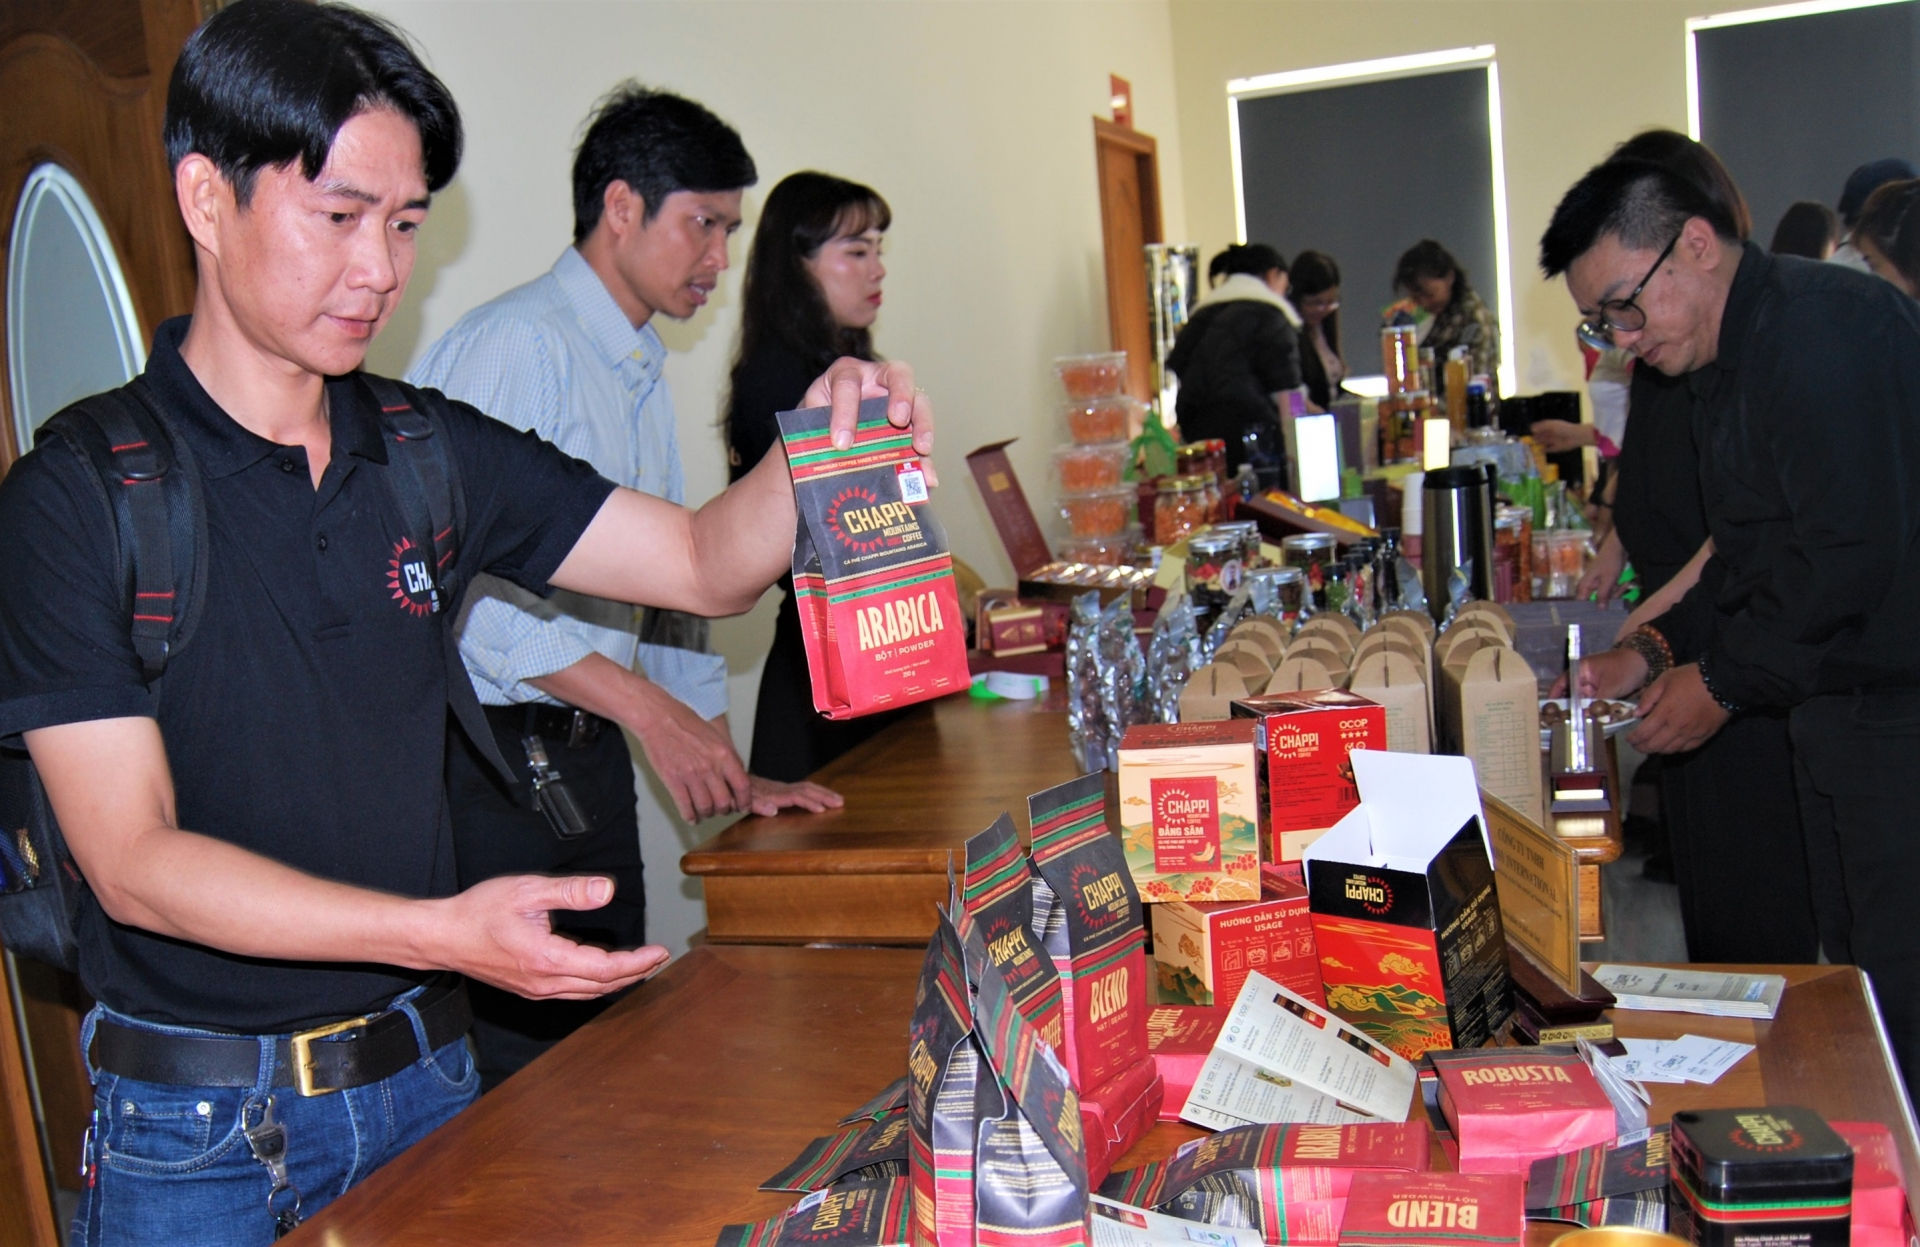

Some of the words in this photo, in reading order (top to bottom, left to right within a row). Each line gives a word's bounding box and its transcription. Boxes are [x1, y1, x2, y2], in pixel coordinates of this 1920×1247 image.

[843, 501, 916, 534] CHAPPI
[883, 522, 920, 537] MOUNTAINS
[902, 531, 923, 543] COFFEE
[856, 591, 944, 651] ARABICA
[875, 650, 893, 662] BỘT
[899, 639, 935, 655] POWDER
[1339, 718, 1368, 729] OCOP
[1280, 733, 1319, 749] CHAPPI
[1167, 799, 1209, 814] CHAPPI
[1082, 872, 1127, 911] CHAPPI
[1345, 884, 1384, 903] CHAPPI
[1255, 921, 1283, 932] USAGE
[987, 924, 1029, 968] CHAPPI
[1089, 967, 1129, 1024] BLEND
[909, 1039, 939, 1095] CHAPPI
[1461, 1065, 1572, 1086] ROBUSTA
[1294, 1123, 1342, 1160] ARABIC
[811, 1191, 847, 1232] CHAPPI
[1387, 1201, 1478, 1230] BLEND
